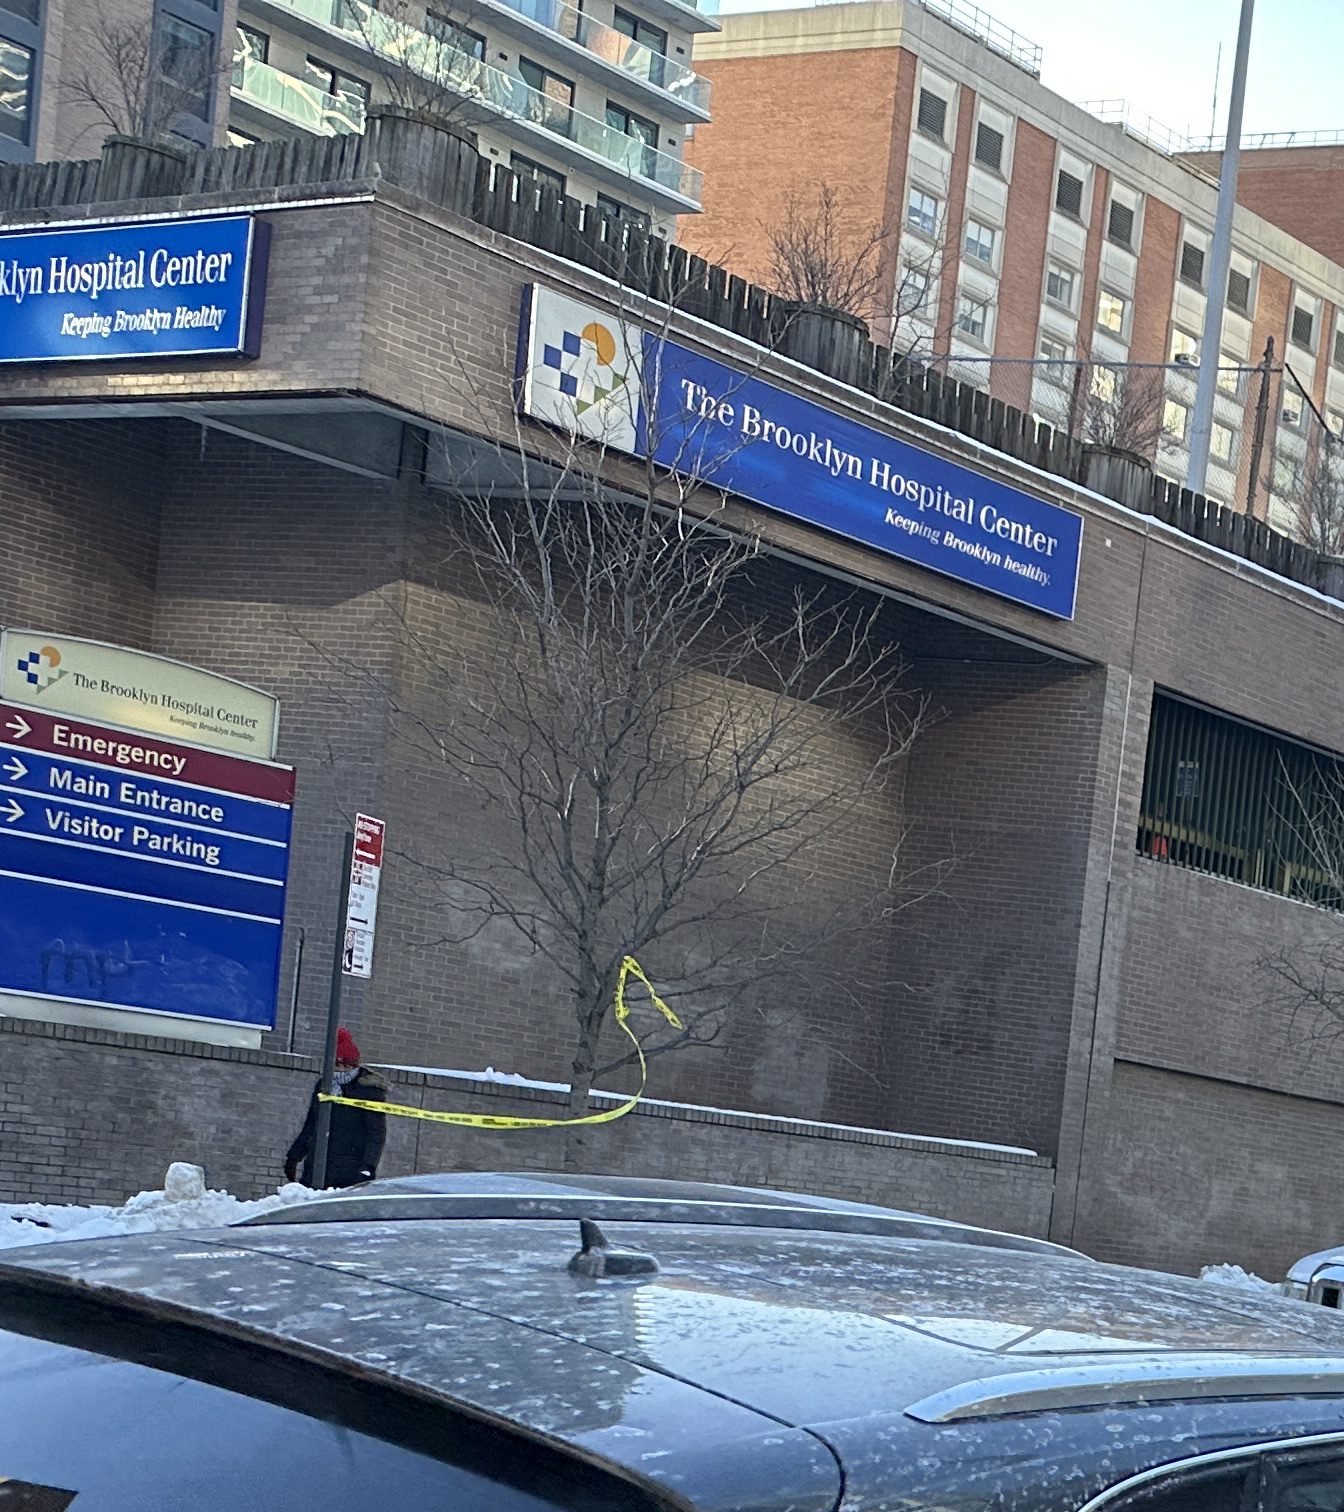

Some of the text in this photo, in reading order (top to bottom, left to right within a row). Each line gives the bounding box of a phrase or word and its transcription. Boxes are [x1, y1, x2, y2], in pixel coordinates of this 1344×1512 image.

[47, 250, 145, 300] Hospital
[150, 248, 232, 288] Center
[61, 304, 226, 339] Keeping Brooklyn Healthy
[681, 378, 1058, 557] The Brooklyn Hospital Center
[885, 507, 941, 546] Keeping
[943, 531, 1001, 567] Brooklyn
[73, 672, 259, 729] The Brooklyn Hospital Center
[53, 723, 188, 776] Emergency
[49, 765, 225, 823] Main Entrance
[45, 808, 221, 865] Visitor Parking
